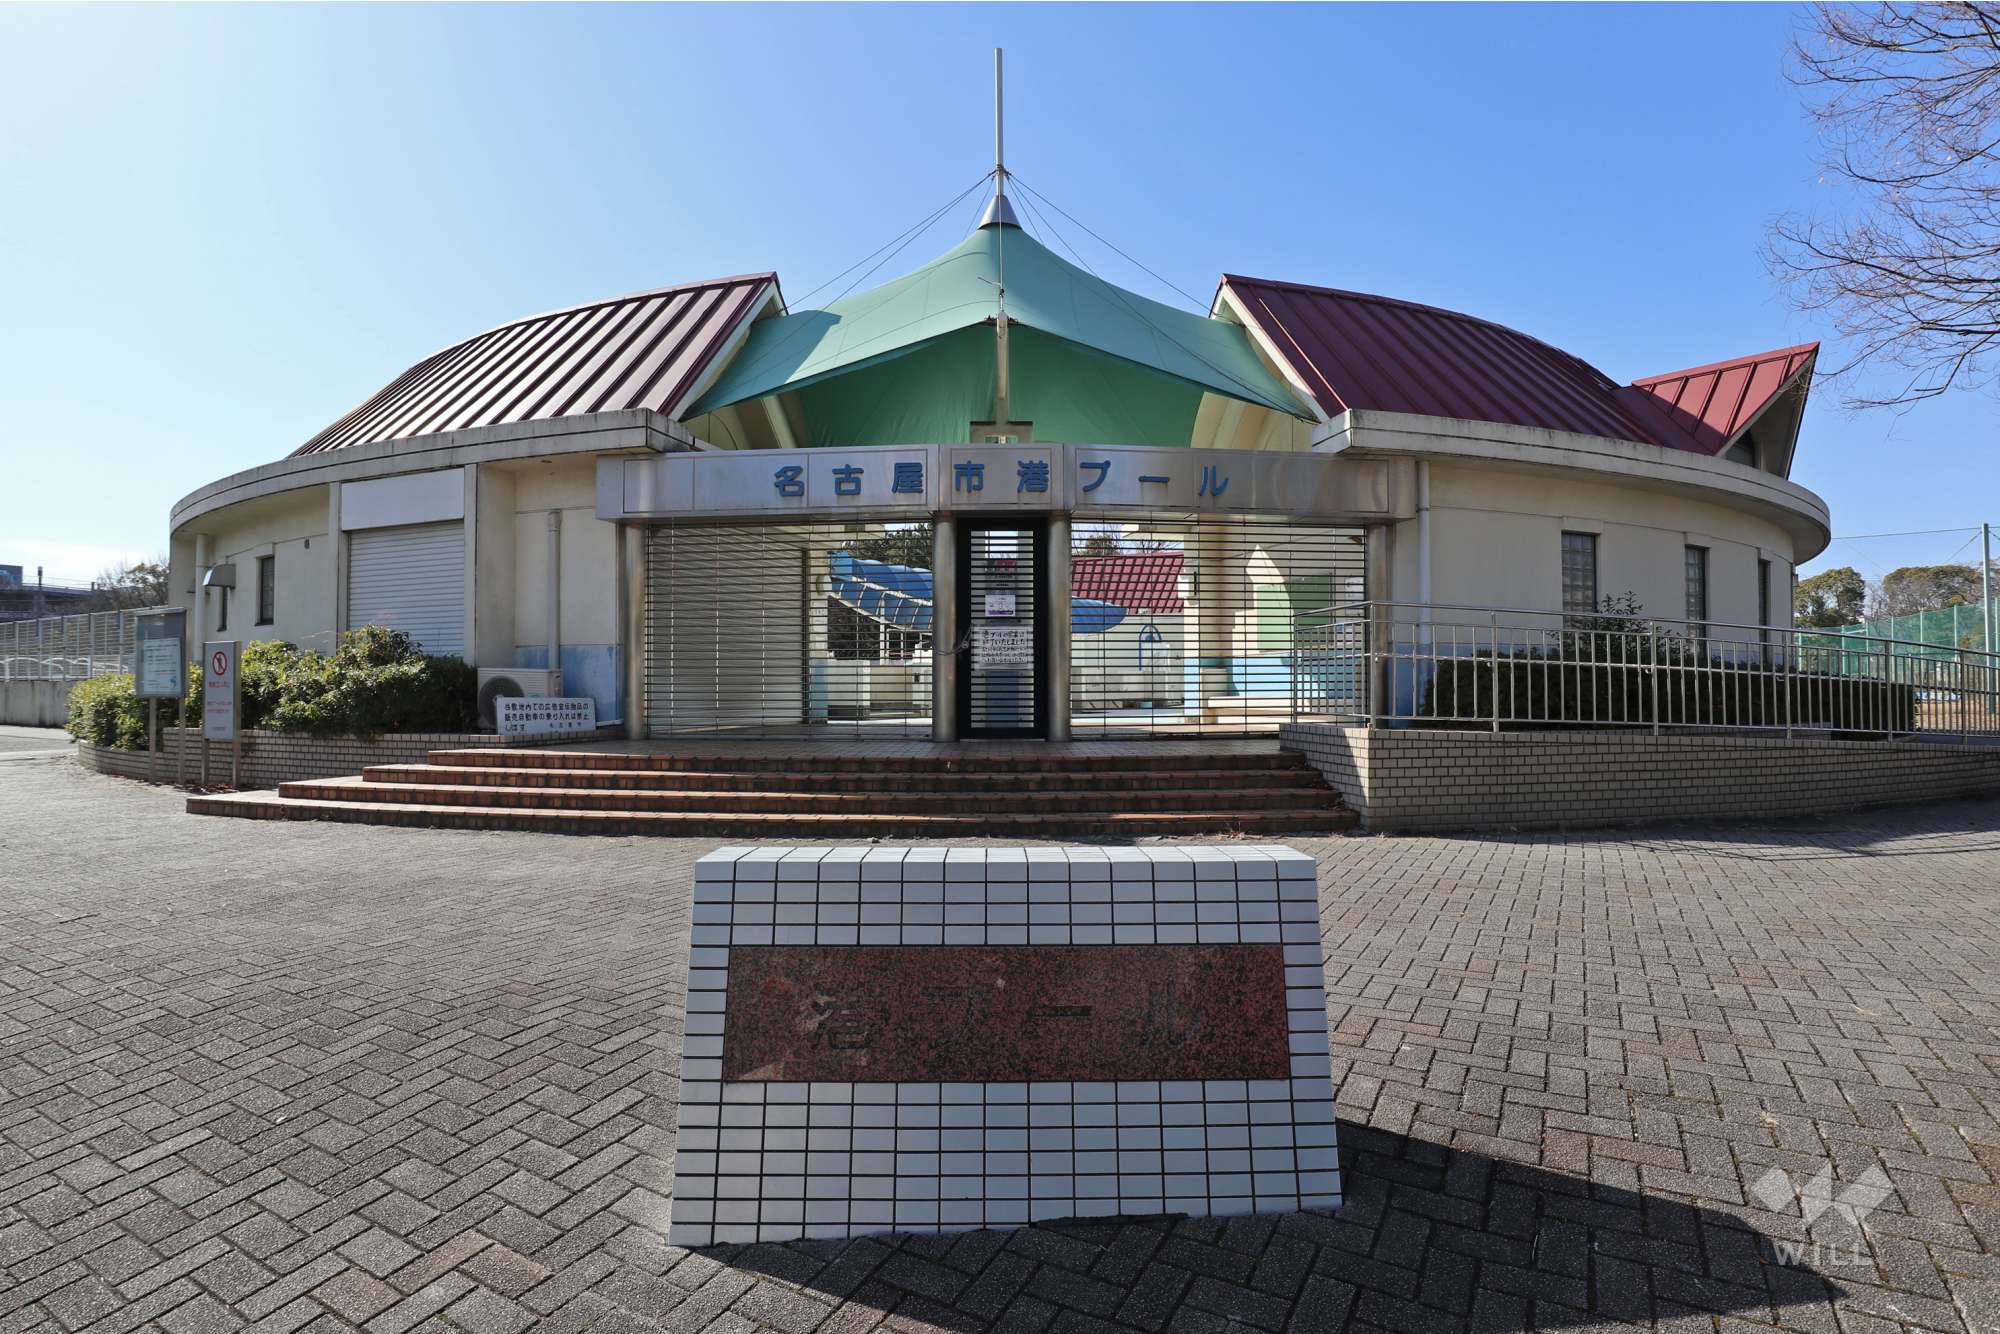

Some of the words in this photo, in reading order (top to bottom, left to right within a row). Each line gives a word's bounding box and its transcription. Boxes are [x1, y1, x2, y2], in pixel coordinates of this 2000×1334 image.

[774, 460, 1229, 497] 名古屋市港プール
